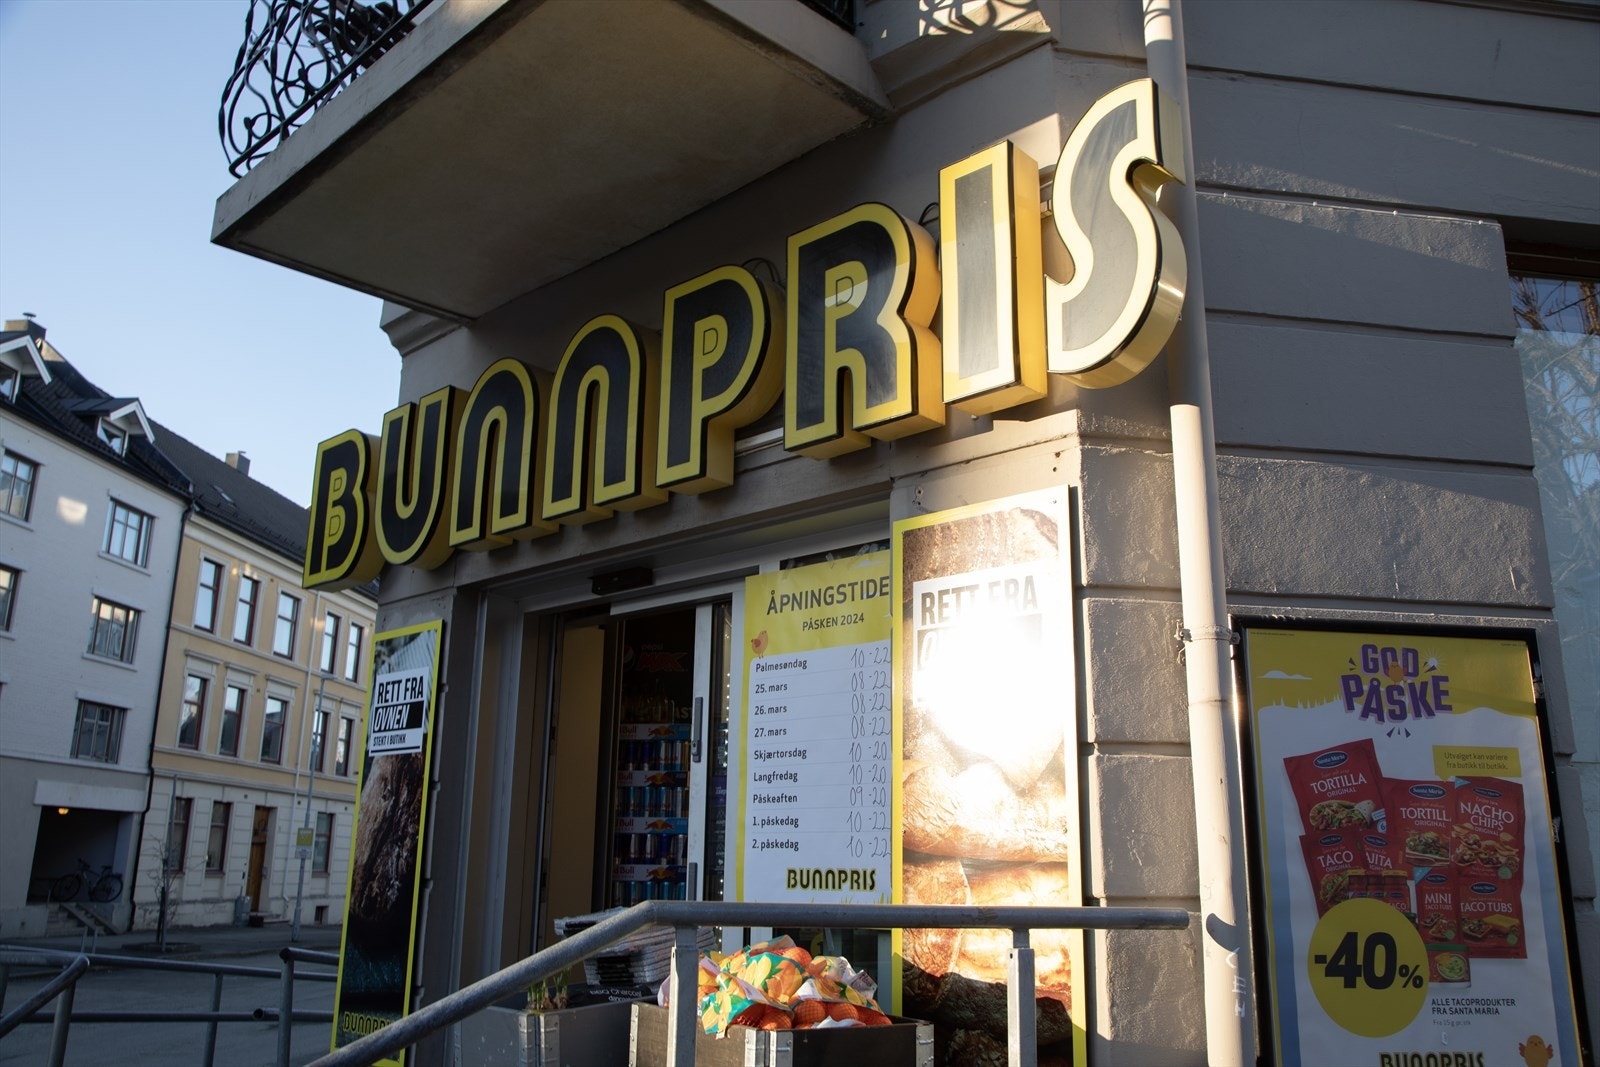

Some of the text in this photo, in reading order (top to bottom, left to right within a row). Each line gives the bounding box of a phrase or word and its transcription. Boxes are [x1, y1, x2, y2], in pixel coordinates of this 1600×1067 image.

[302, 78, 1187, 590] BUNNPRIS
[802, 613, 865, 631] PÅSKEN 2024
[755, 659, 807, 672] Palmesøndag
[1361, 643, 1420, 678] GOD
[377, 675, 424, 705] RETT FRA
[755, 683, 788, 694] 25. mars
[1340, 674, 1453, 723] PÅSKE
[754, 705, 787, 715] 26. mars
[374, 704, 410, 732] OVNEN
[754, 728, 787, 738] 27. mars
[373, 734, 386, 747] STEKT
[389, 733, 406, 745] BUTIKK
[754, 747, 807, 761] Skjærtorsdag
[1444, 752, 1472, 761] Utvalget
[1486, 753, 1508, 761] variere
[1457, 761, 1477, 769] butikk
[753, 770, 798, 784] Langfredag
[1310, 772, 1367, 794] TORTILLA
[752, 793, 798, 804] Påskeaften
[1327, 786, 1357, 798] ORIGINAL
[1400, 807, 1451, 822] TORTILL
[1460, 802, 1514, 824] NACHO
[752, 816, 799, 828] 1. påskedag
[1414, 820, 1446, 828] ORIGINAL
[1470, 815, 1504, 832] CHIPS
[1474, 826, 1499, 837] ORIGINAL
[752, 838, 799, 851] 2. påskedag
[1317, 850, 1354, 868] TACO
[786, 867, 877, 891] BUNNPRIS
[1424, 893, 1451, 904] MINI
[1460, 902, 1513, 913] TACO TUBS
[1314, 931, 1424, 990] -40%
[1431, 998, 1516, 1007] ALLE TACOPRODUKTER
[1432, 1007, 1500, 1015] FRA SANTA MARIA
